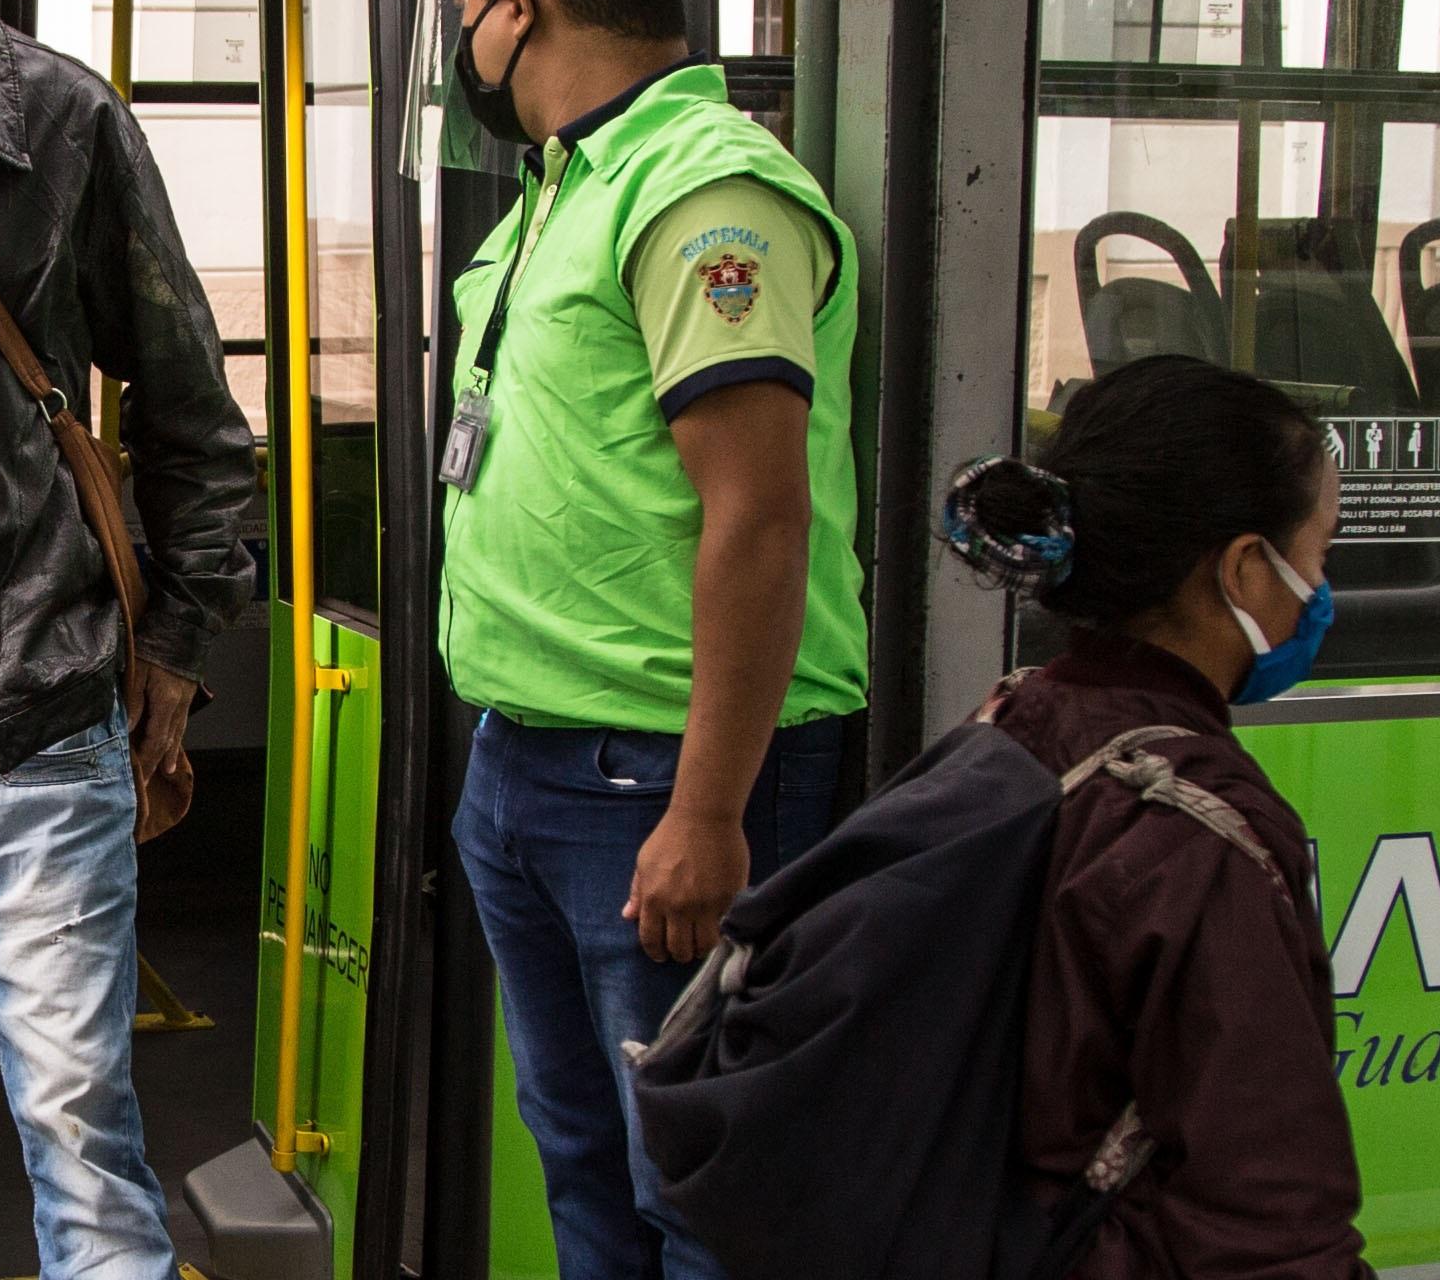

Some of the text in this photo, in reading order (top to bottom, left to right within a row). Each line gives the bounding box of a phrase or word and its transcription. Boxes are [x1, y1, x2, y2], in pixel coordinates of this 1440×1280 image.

[679, 226, 770, 262] GUATEMALA
[309, 842, 331, 896] NO
[267, 876, 369, 995] PEANECER
